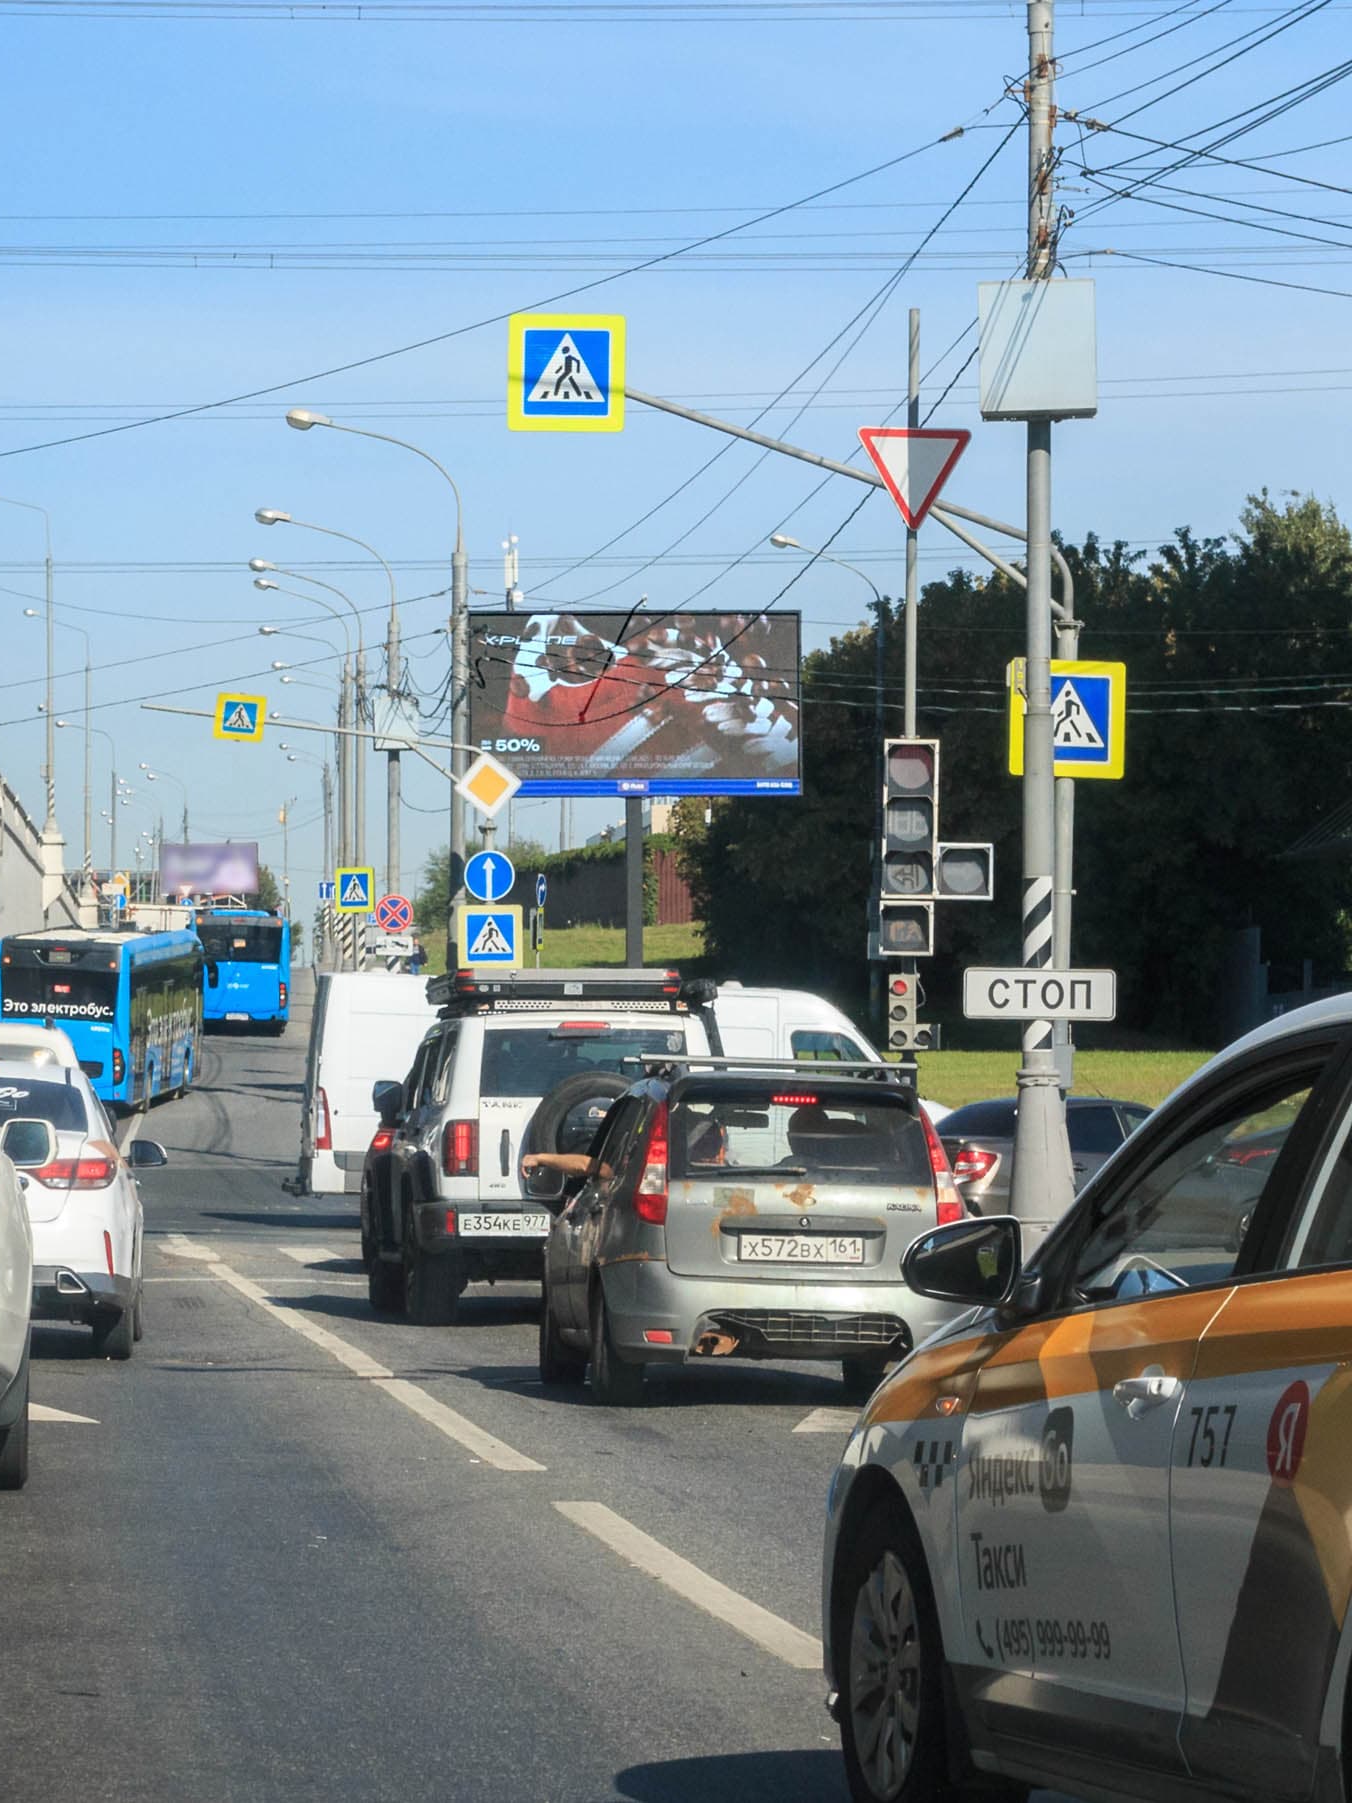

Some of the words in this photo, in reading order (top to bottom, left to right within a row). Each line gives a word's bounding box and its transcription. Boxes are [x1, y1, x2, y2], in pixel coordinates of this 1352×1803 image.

[484, 633, 578, 646] X-PLNE
[495, 738, 541, 752] 50%
[3, 999, 29, 1012] Это
[31, 1003, 114, 1018] электробус.
[988, 978, 1092, 1010] СТОП
[523, 1215, 546, 1227] 977
[829, 1239, 857, 1254] 161
[1187, 1404, 1238, 1467] 757
[1275, 1402, 1302, 1471] Я
[968, 1441, 1035, 1507] Яндекс
[1042, 1430, 1069, 1490] Go
[970, 1532, 1027, 1590] Такси
[995, 1617, 1036, 1663] (495)
[1036, 1619, 1111, 1660] 999-99-99
